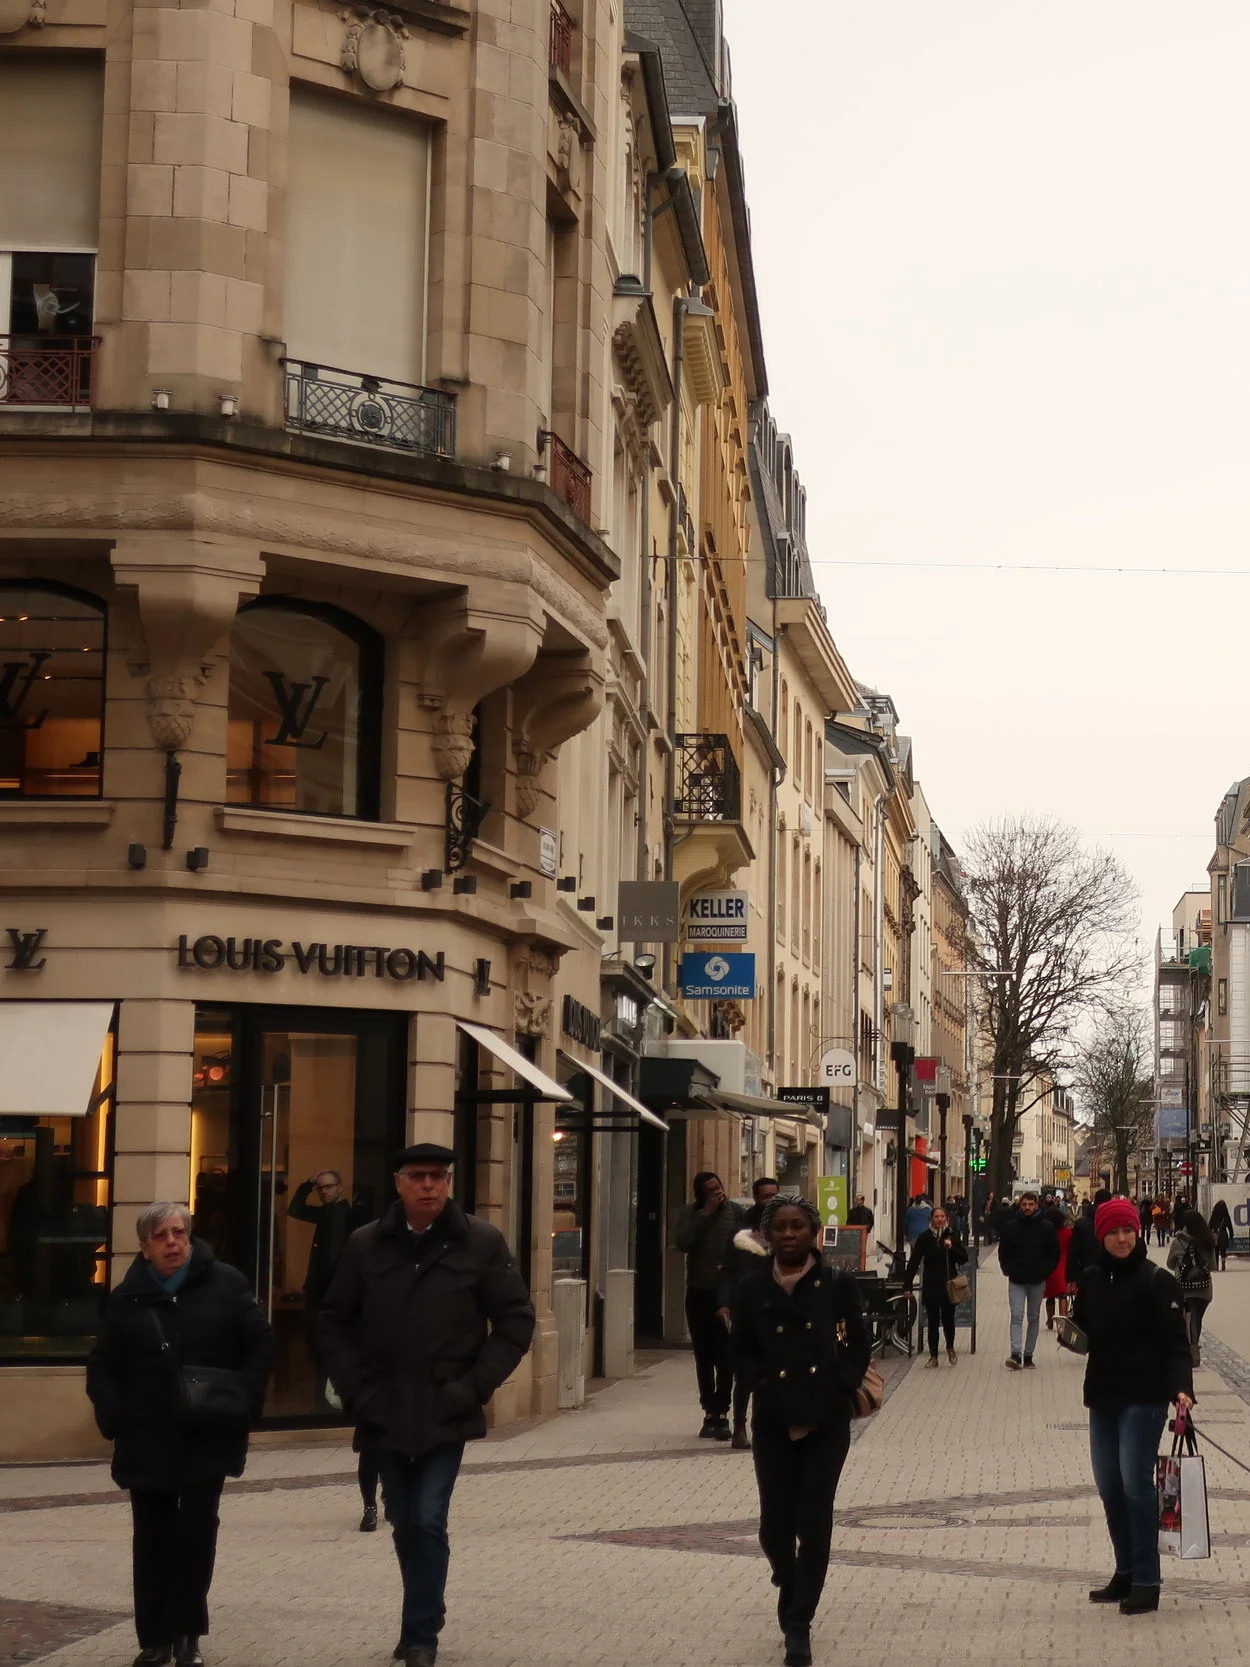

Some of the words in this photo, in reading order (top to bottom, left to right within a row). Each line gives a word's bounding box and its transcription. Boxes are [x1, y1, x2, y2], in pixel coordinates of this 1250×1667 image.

[262, 670, 331, 750] LV
[689, 898, 744, 919] KELLER
[621, 915, 674, 927] IKKS
[689, 926, 746, 938] MAROQUINERIE
[5, 928, 49, 970] LV
[176, 934, 286, 973] LOUIS
[291, 941, 445, 983] VUITTON
[685, 984, 750, 996] Samsonite
[825, 1064, 852, 1077] EFG
